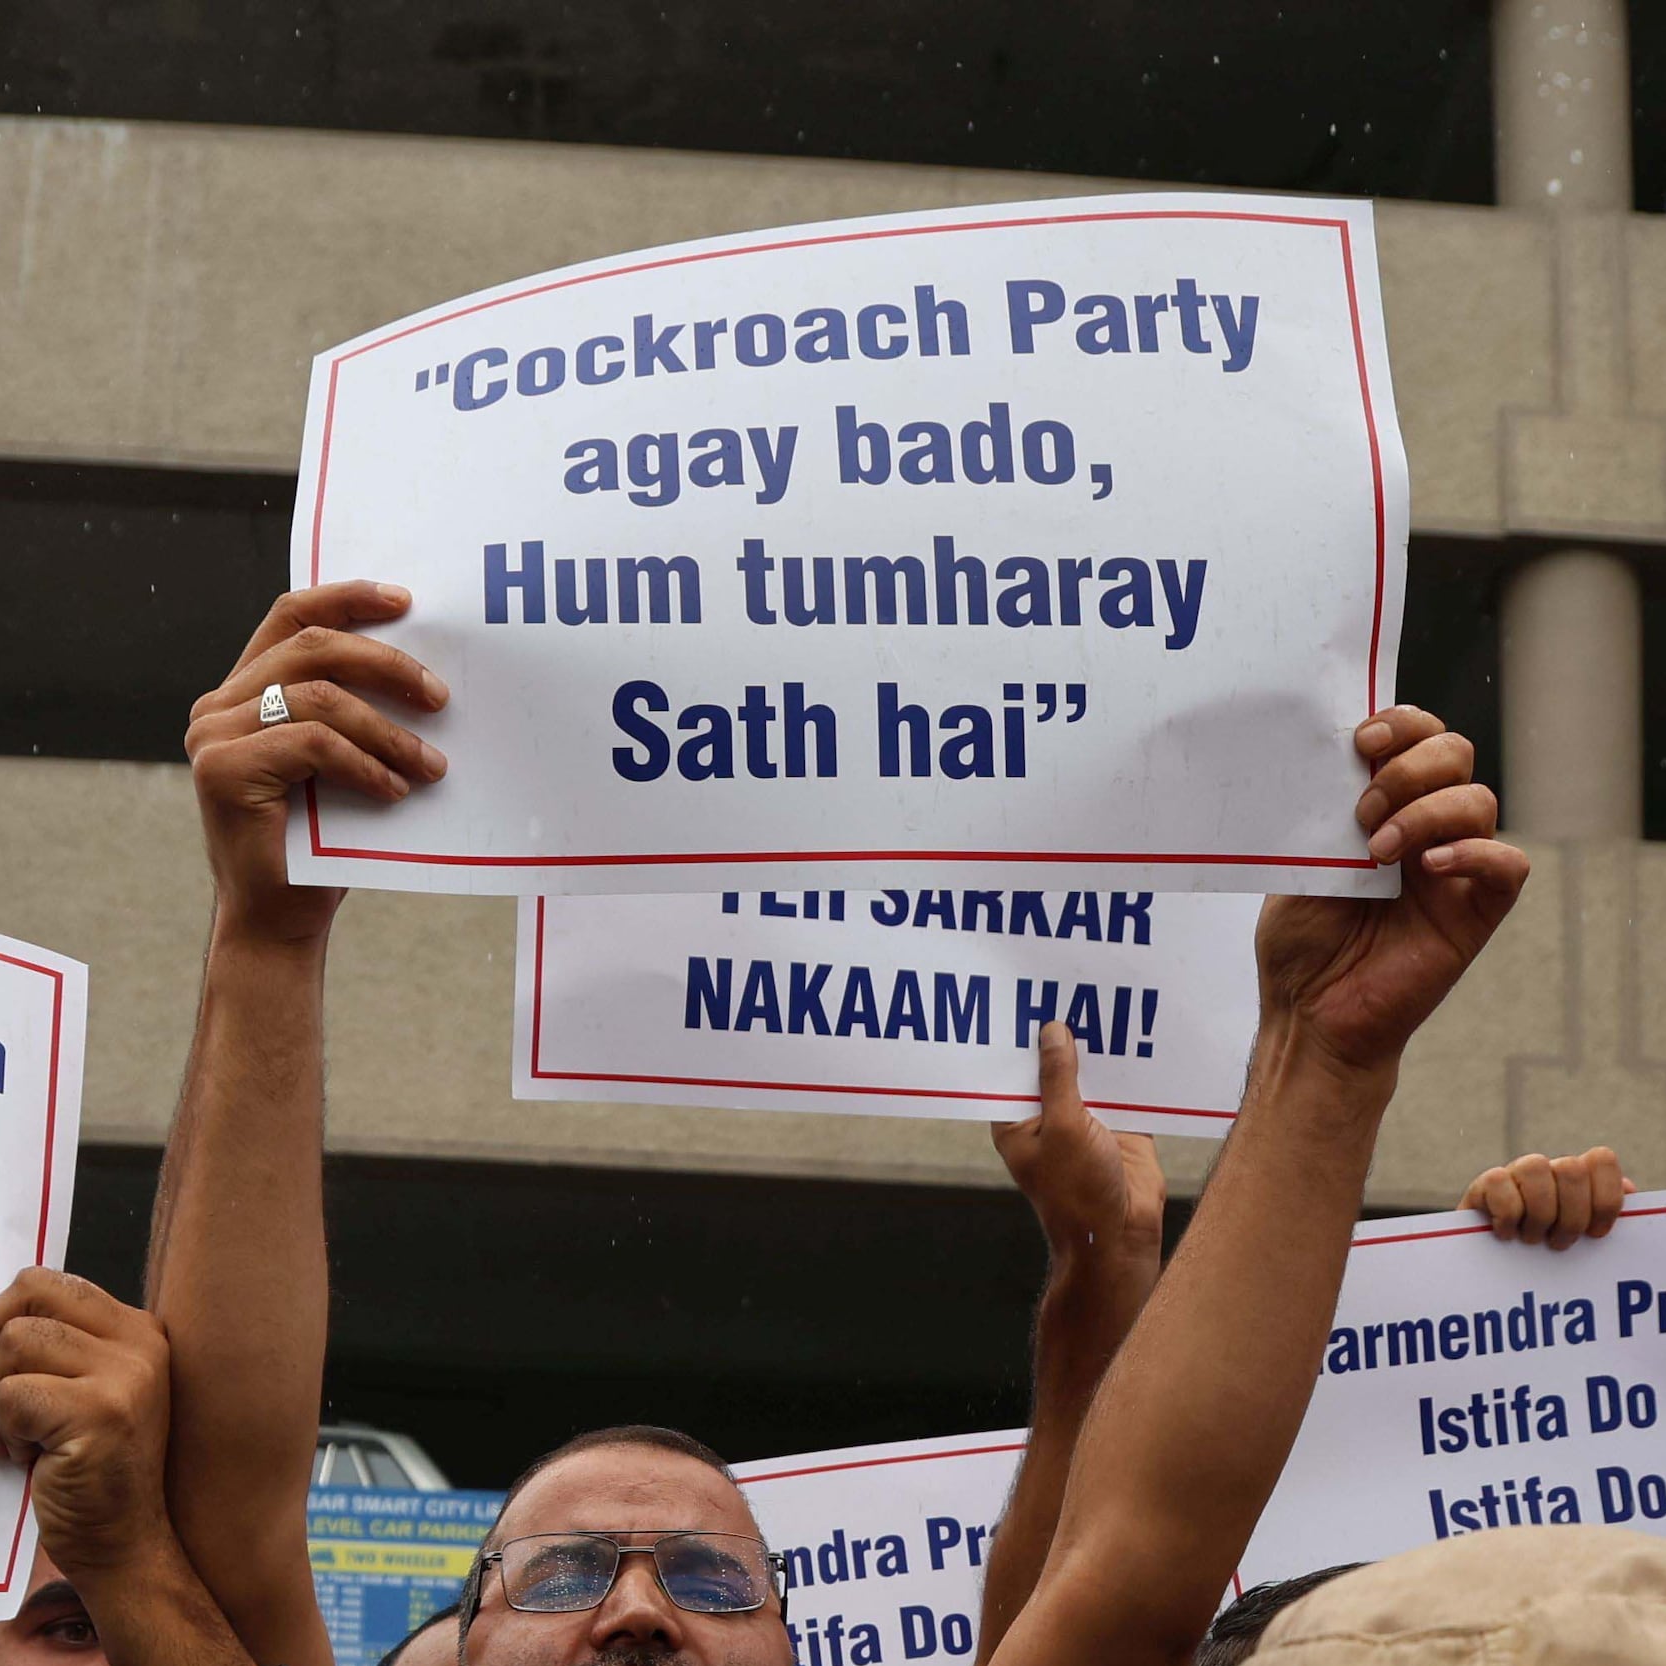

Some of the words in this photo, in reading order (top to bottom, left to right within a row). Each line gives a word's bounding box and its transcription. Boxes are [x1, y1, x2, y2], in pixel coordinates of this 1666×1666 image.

[416, 284, 971, 413] "Cockroach
[1007, 278, 1260, 373] Party
[565, 426, 799, 507] agay
[836, 403, 1112, 498] bado,
[484, 541, 702, 626] Hum
[737, 536, 1209, 652] tumharay
[613, 681, 839, 782] Sath
[876, 682, 1087, 780] hai”
[686, 956, 991, 1046] NAKAAM
[1015, 978, 1158, 1058] HAI!
[1320, 1290, 1598, 1374] armendra
[1420, 1385, 1569, 1455] Istifa
[1586, 1375, 1659, 1433] Do
[351, 1495, 422, 1516] SMART
[425, 1499, 470, 1518] CITY
[369, 1518, 414, 1537] CAR
[1428, 1475, 1582, 1539] Istifa
[783, 1527, 910, 1589] ndra
[926, 1515, 1001, 1570] Pr
[900, 1604, 973, 1659] Do
